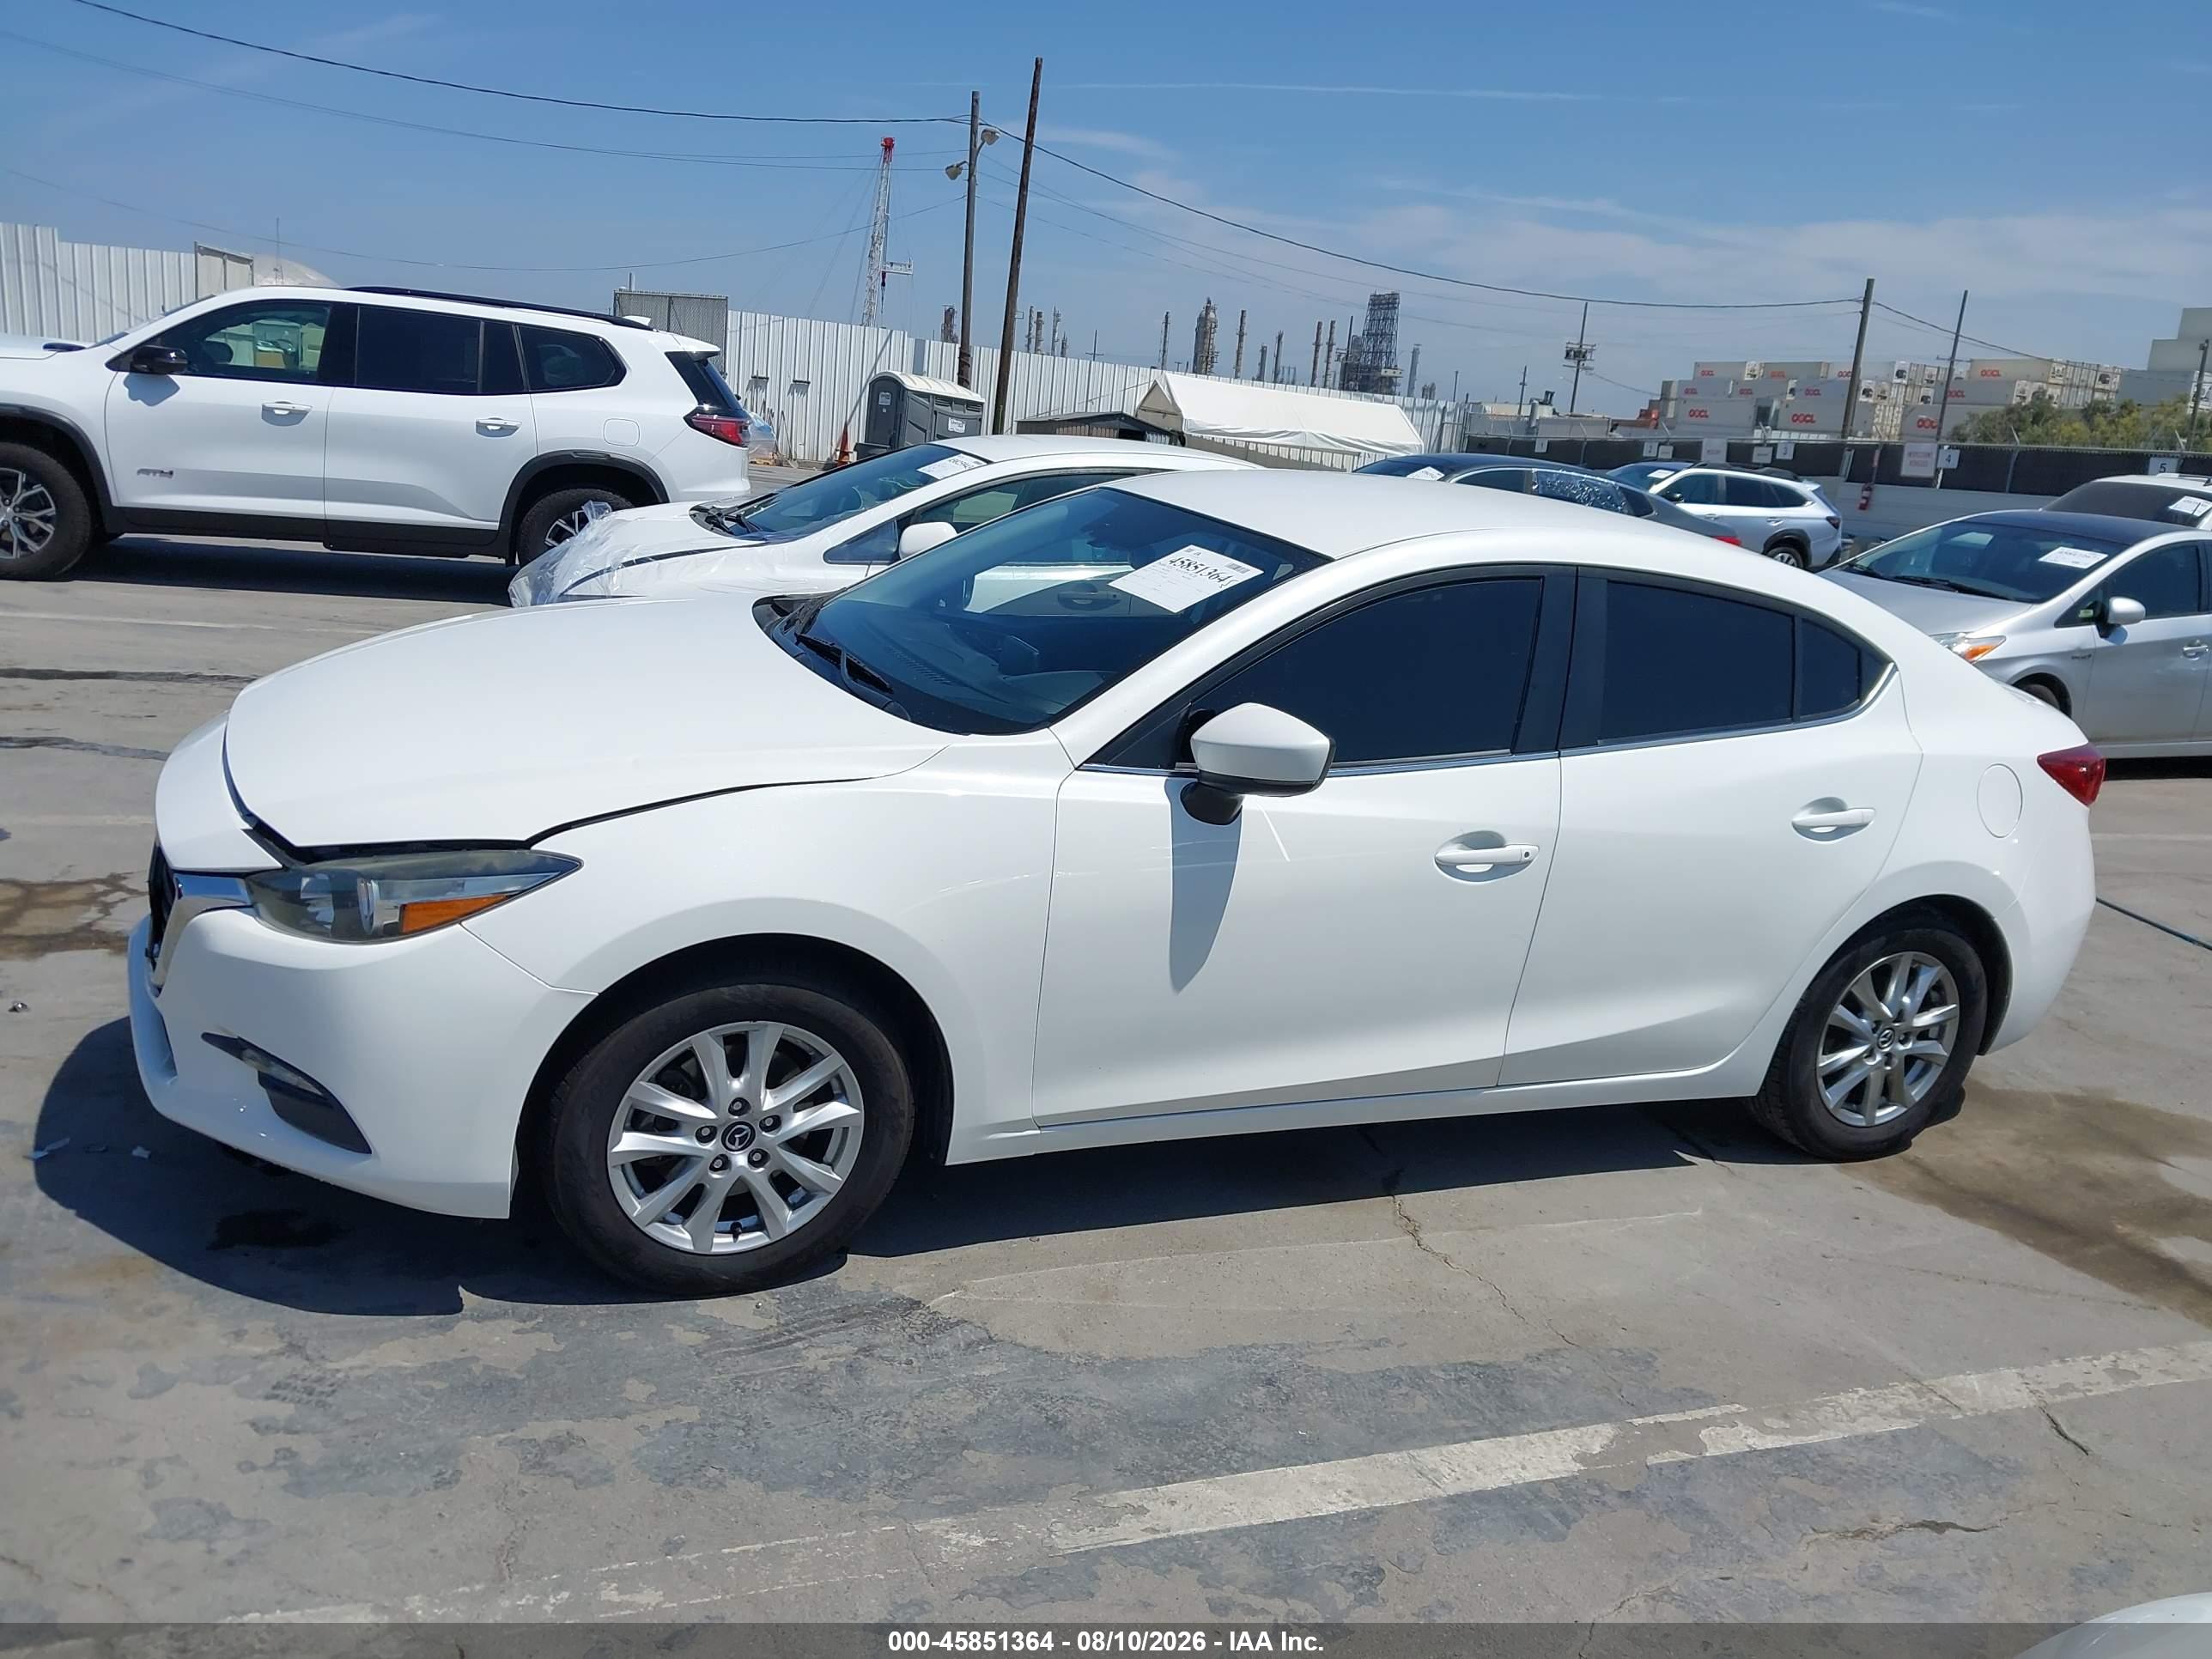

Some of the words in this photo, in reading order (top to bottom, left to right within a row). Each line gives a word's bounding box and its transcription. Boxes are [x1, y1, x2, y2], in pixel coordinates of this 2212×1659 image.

[1688, 409, 1709, 418] OOCL
[1791, 413, 1816, 423] OOCL
[1917, 417, 1938, 429] OOC
[1944, 454, 1952, 465] 4
[2159, 463, 2167, 473] 5
[1169, 556, 1234, 583] 45851364
